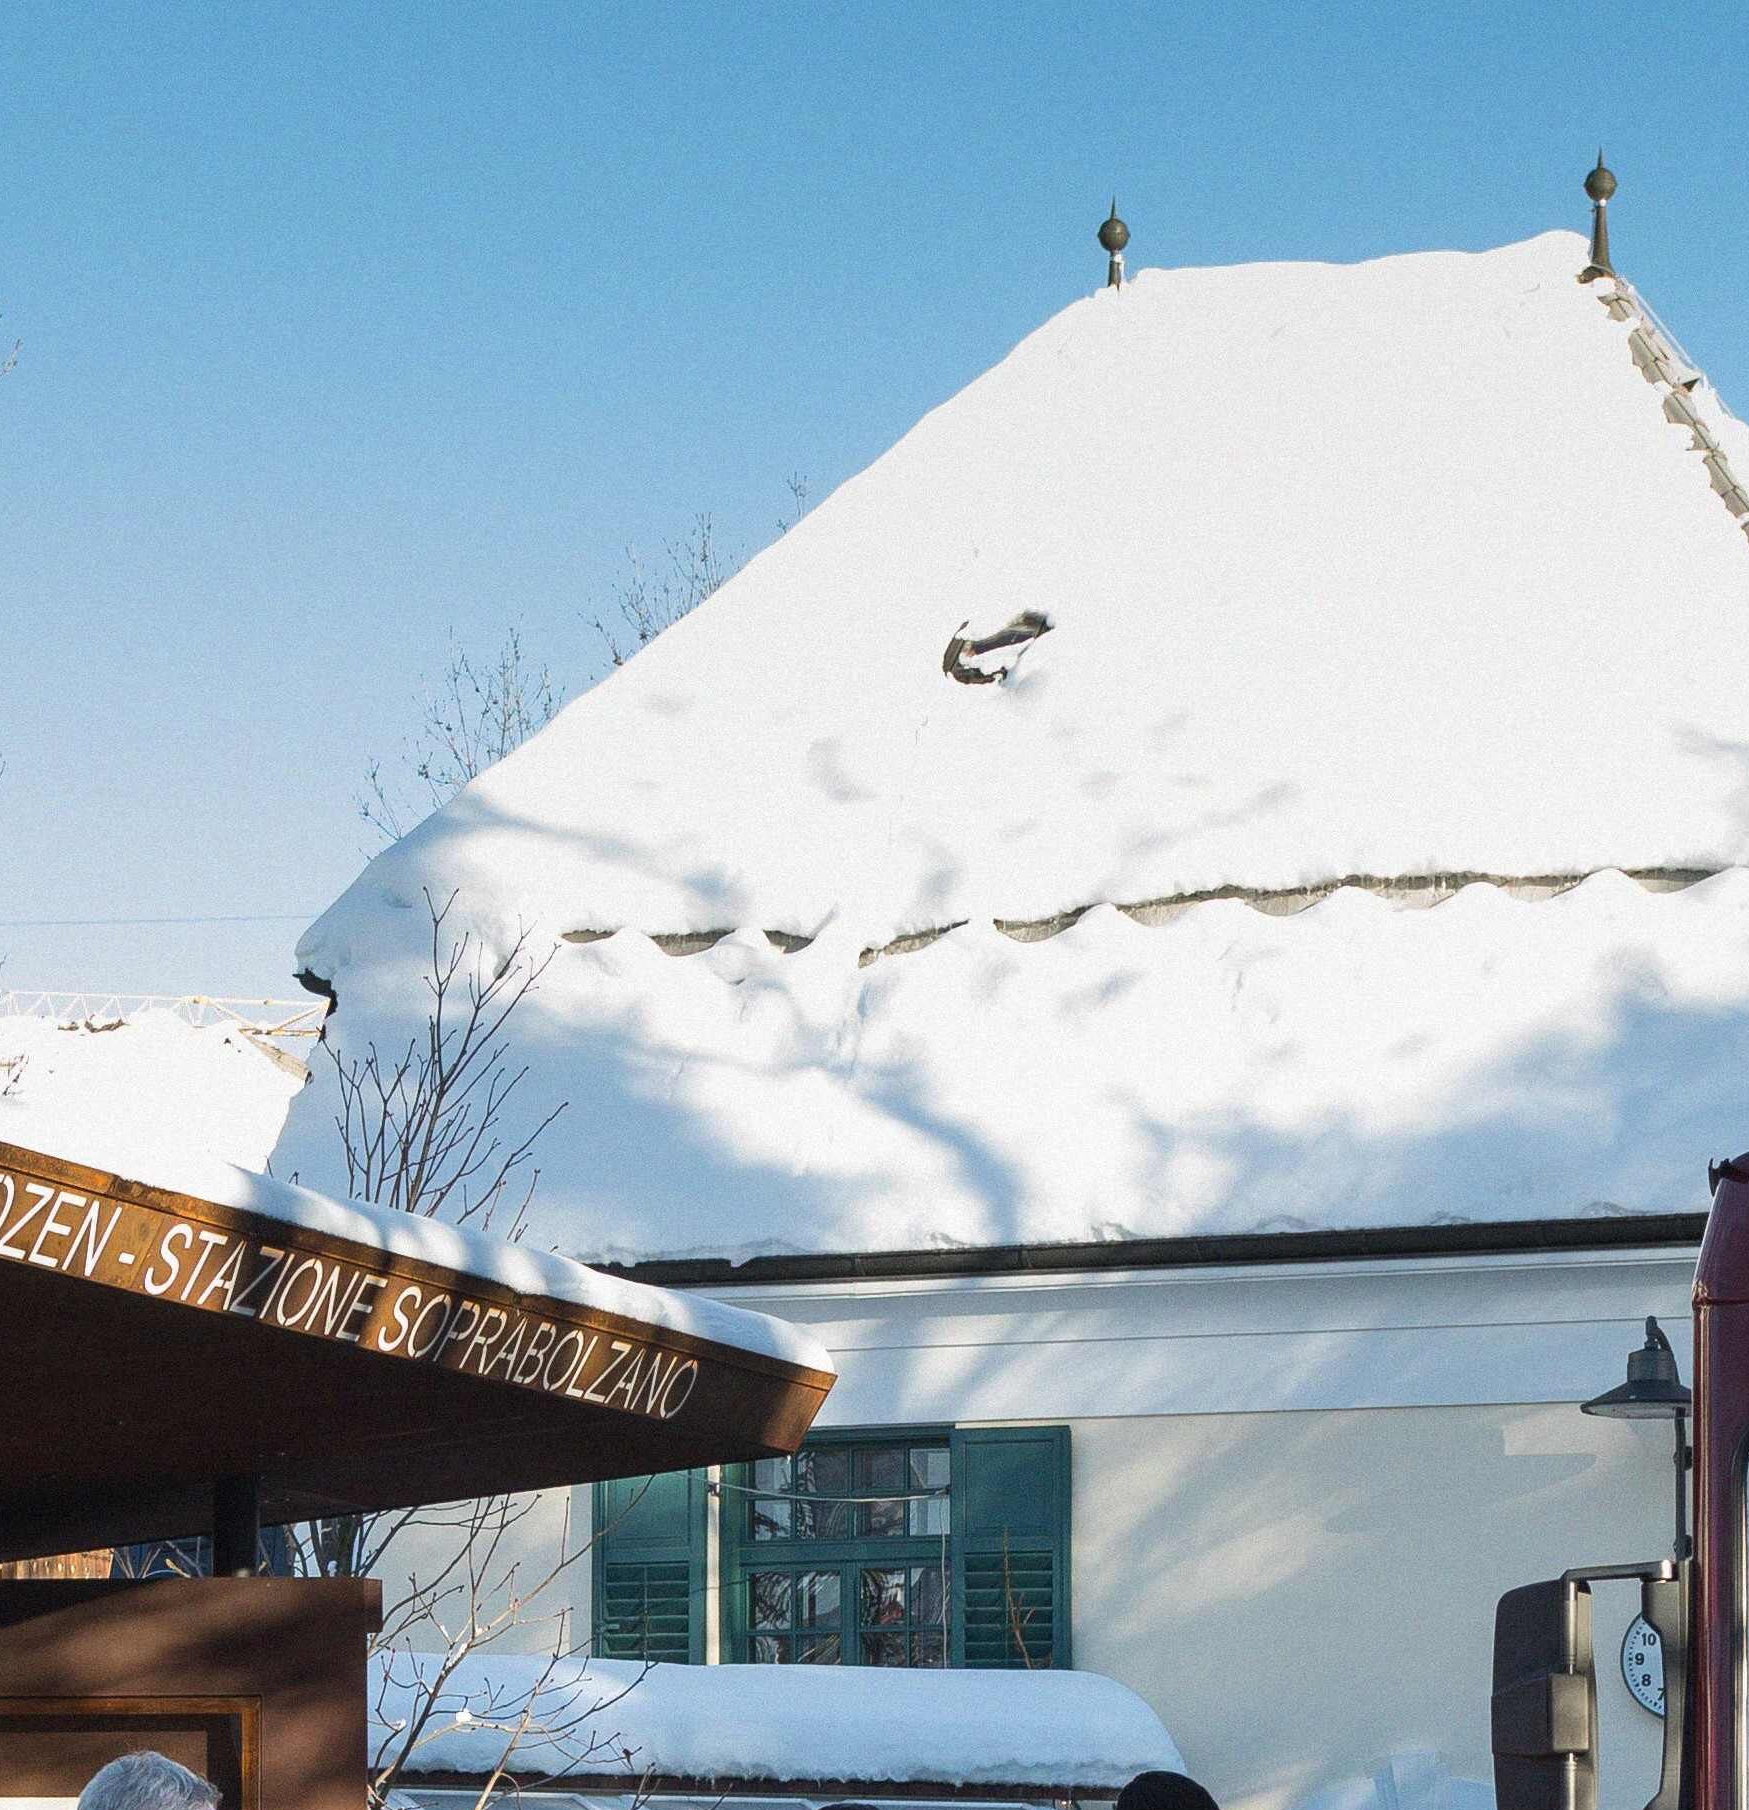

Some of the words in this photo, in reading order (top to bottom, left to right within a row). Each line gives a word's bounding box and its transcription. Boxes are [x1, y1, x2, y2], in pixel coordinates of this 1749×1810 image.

[144, 1222, 389, 1344] STAZIONE
[377, 1285, 699, 1420] SOPRABOLZANO
[1641, 1632, 1657, 1646] 10
[1634, 1652, 1645, 1666] 9
[1641, 1673, 1652, 1687] 8
